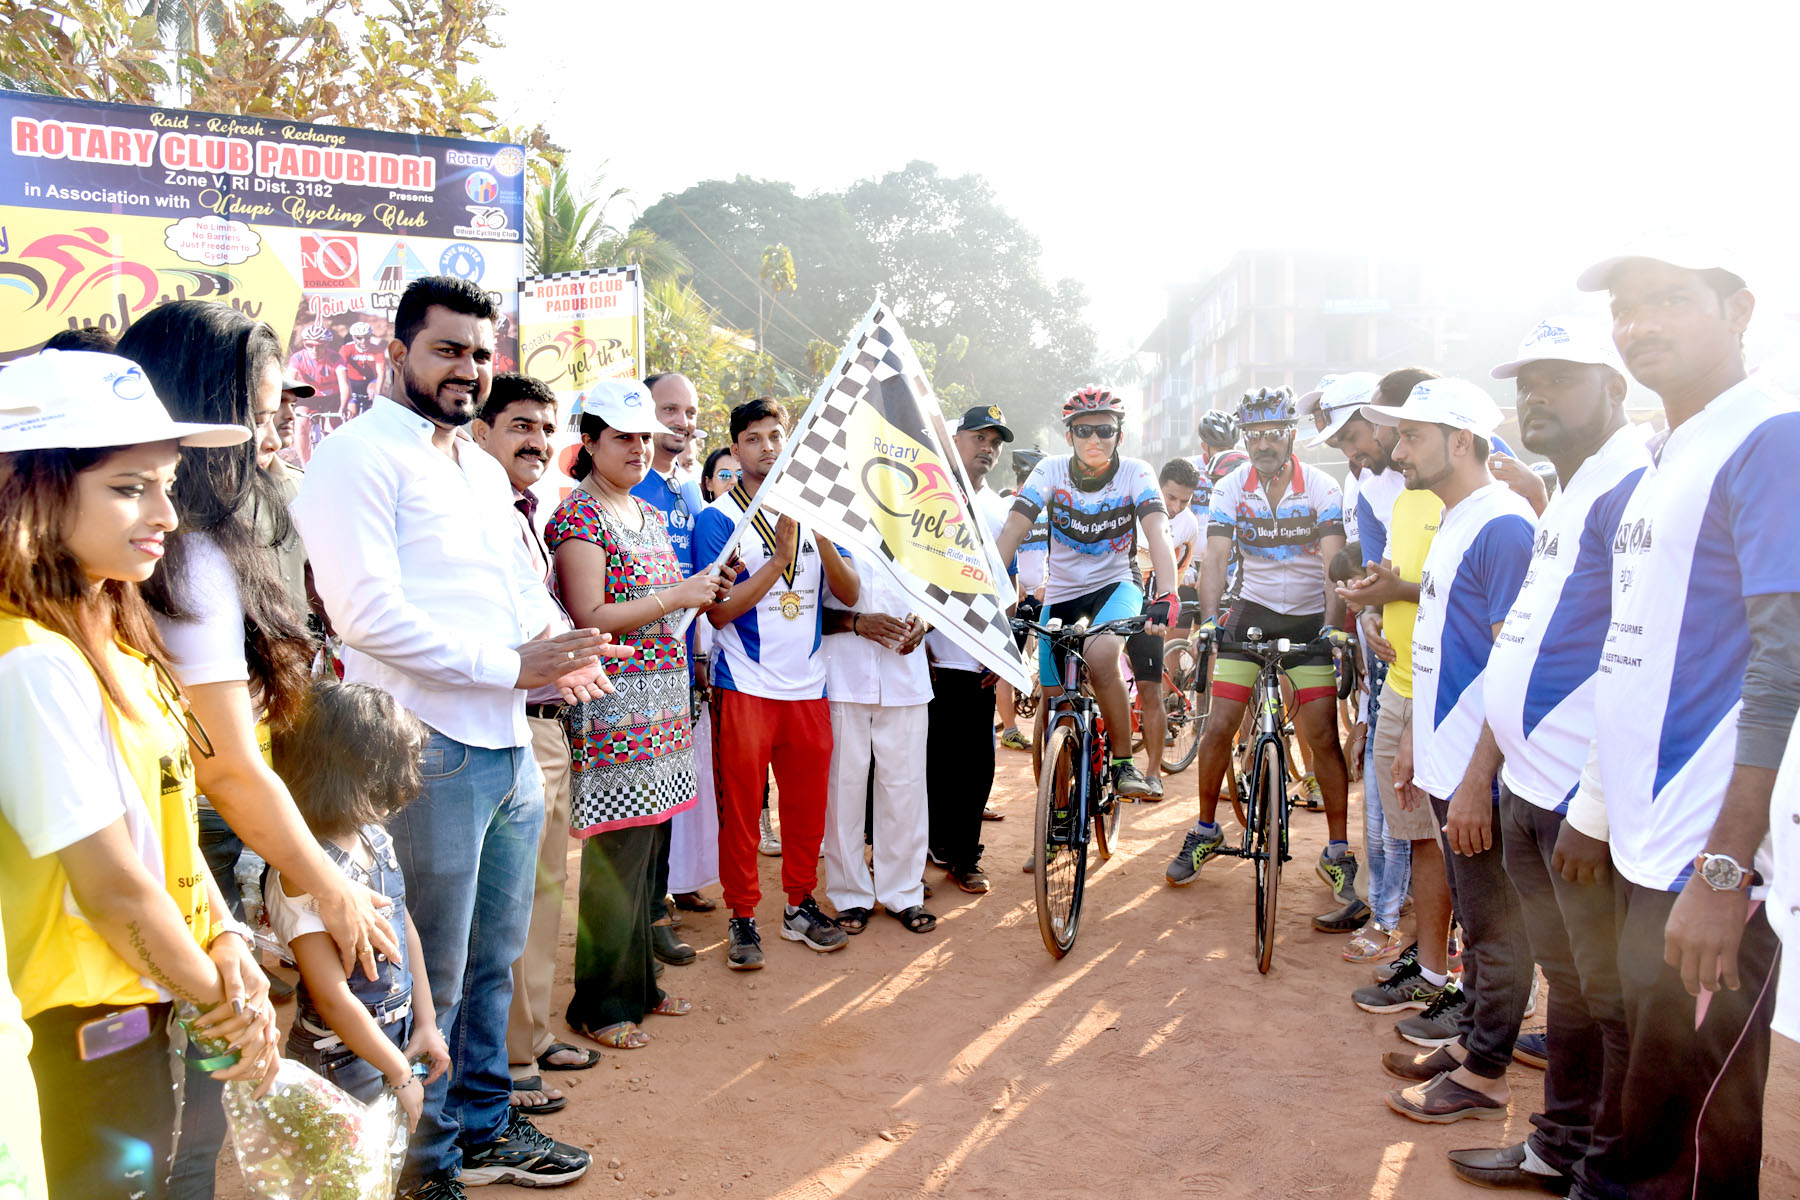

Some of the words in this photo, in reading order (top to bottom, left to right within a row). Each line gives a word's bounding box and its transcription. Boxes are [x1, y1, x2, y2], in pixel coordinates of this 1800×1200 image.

[149, 112, 189, 130] Raid
[206, 117, 265, 138] Refresh
[281, 125, 346, 148] Recharge
[13, 117, 157, 166] ROTARY
[161, 132, 252, 174] CLUB
[257, 141, 435, 190] PADUBIDRI
[447, 151, 493, 168] Rotary
[164, 170, 208, 187] Zone
[212, 174, 227, 191] V,
[232, 178, 249, 191] RI
[254, 179, 291, 194] Dist.
[295, 182, 333, 198] 3182
[24, 182, 41, 197] in
[45, 184, 150, 206] Association
[154, 195, 190, 209] with
[199, 188, 274, 220] Udupi
[282, 196, 366, 228] Cycling
[373, 203, 428, 230] Club
[389, 191, 434, 203] Presents
[192, 231, 204, 239] No
[207, 232, 241, 241] Barriers
[196, 222, 208, 230] No
[210, 223, 237, 232] Limits
[455, 228, 475, 236] Udupi
[476, 229, 501, 238] Cycling
[502, 230, 517, 238] Club
[180, 240, 199, 249] Just
[201, 241, 239, 251] Freedom
[241, 244, 250, 252] to
[441, 247, 457, 265] SAVE
[457, 245, 481, 263] WATER
[204, 251, 229, 260] Cycle
[304, 279, 345, 288] TOBACCO
[537, 282, 586, 299] ROTARY
[589, 279, 623, 294] CLUB
[309, 295, 347, 324] Join
[350, 296, 365, 311] us
[371, 292, 401, 309] Let's
[546, 295, 617, 312] PADUBIDRI
[520, 329, 552, 353] Rotary
[874, 436, 920, 462] Rotary
[1070, 518, 1090, 534] Udupi
[1091, 518, 1117, 534] Cycling
[1118, 513, 1132, 526] Club
[1280, 526, 1311, 538] Cycling
[946, 548, 964, 561] Ride
[965, 555, 981, 566] with
[961, 564, 989, 585] 201
